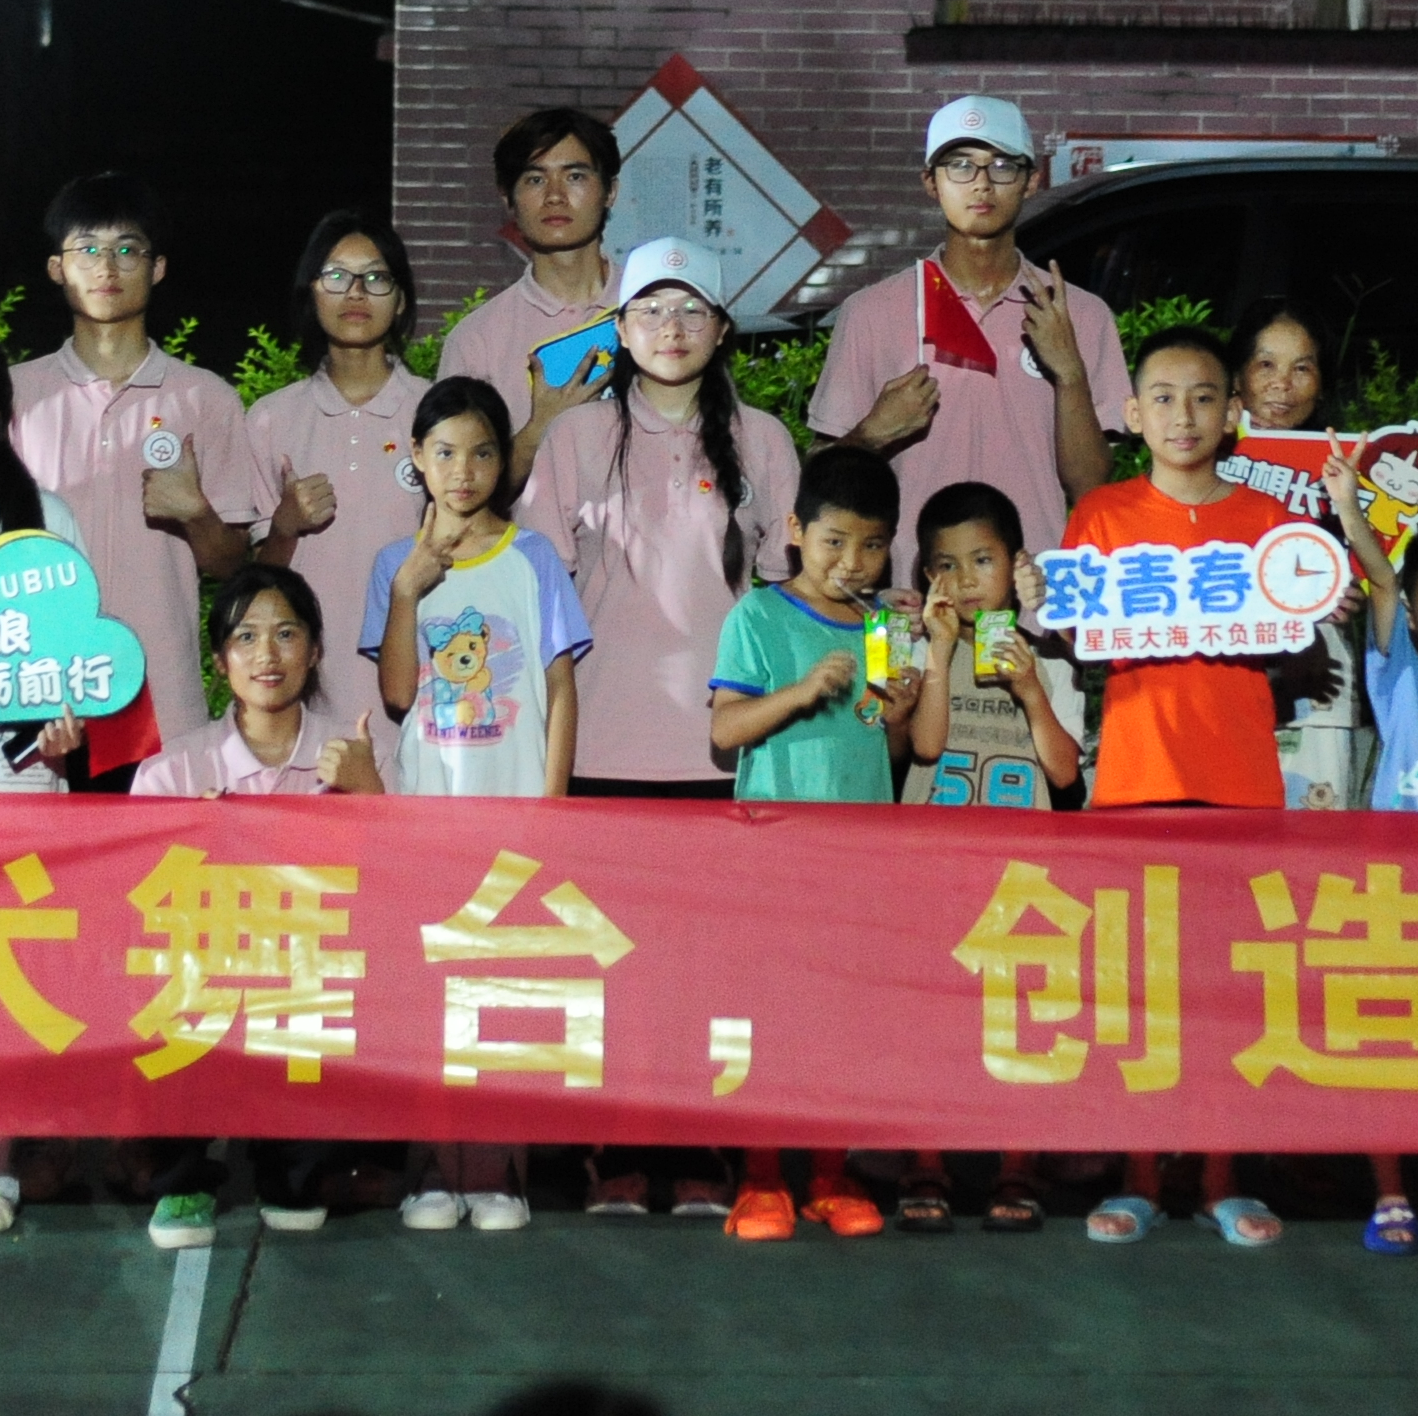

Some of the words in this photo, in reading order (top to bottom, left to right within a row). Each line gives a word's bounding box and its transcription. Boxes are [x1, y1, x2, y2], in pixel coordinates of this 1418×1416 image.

[1042, 549, 1253, 621] 致青春
[1083, 625, 1191, 653] 星辰大海
[1198, 620, 1307, 648] 不负韶华
